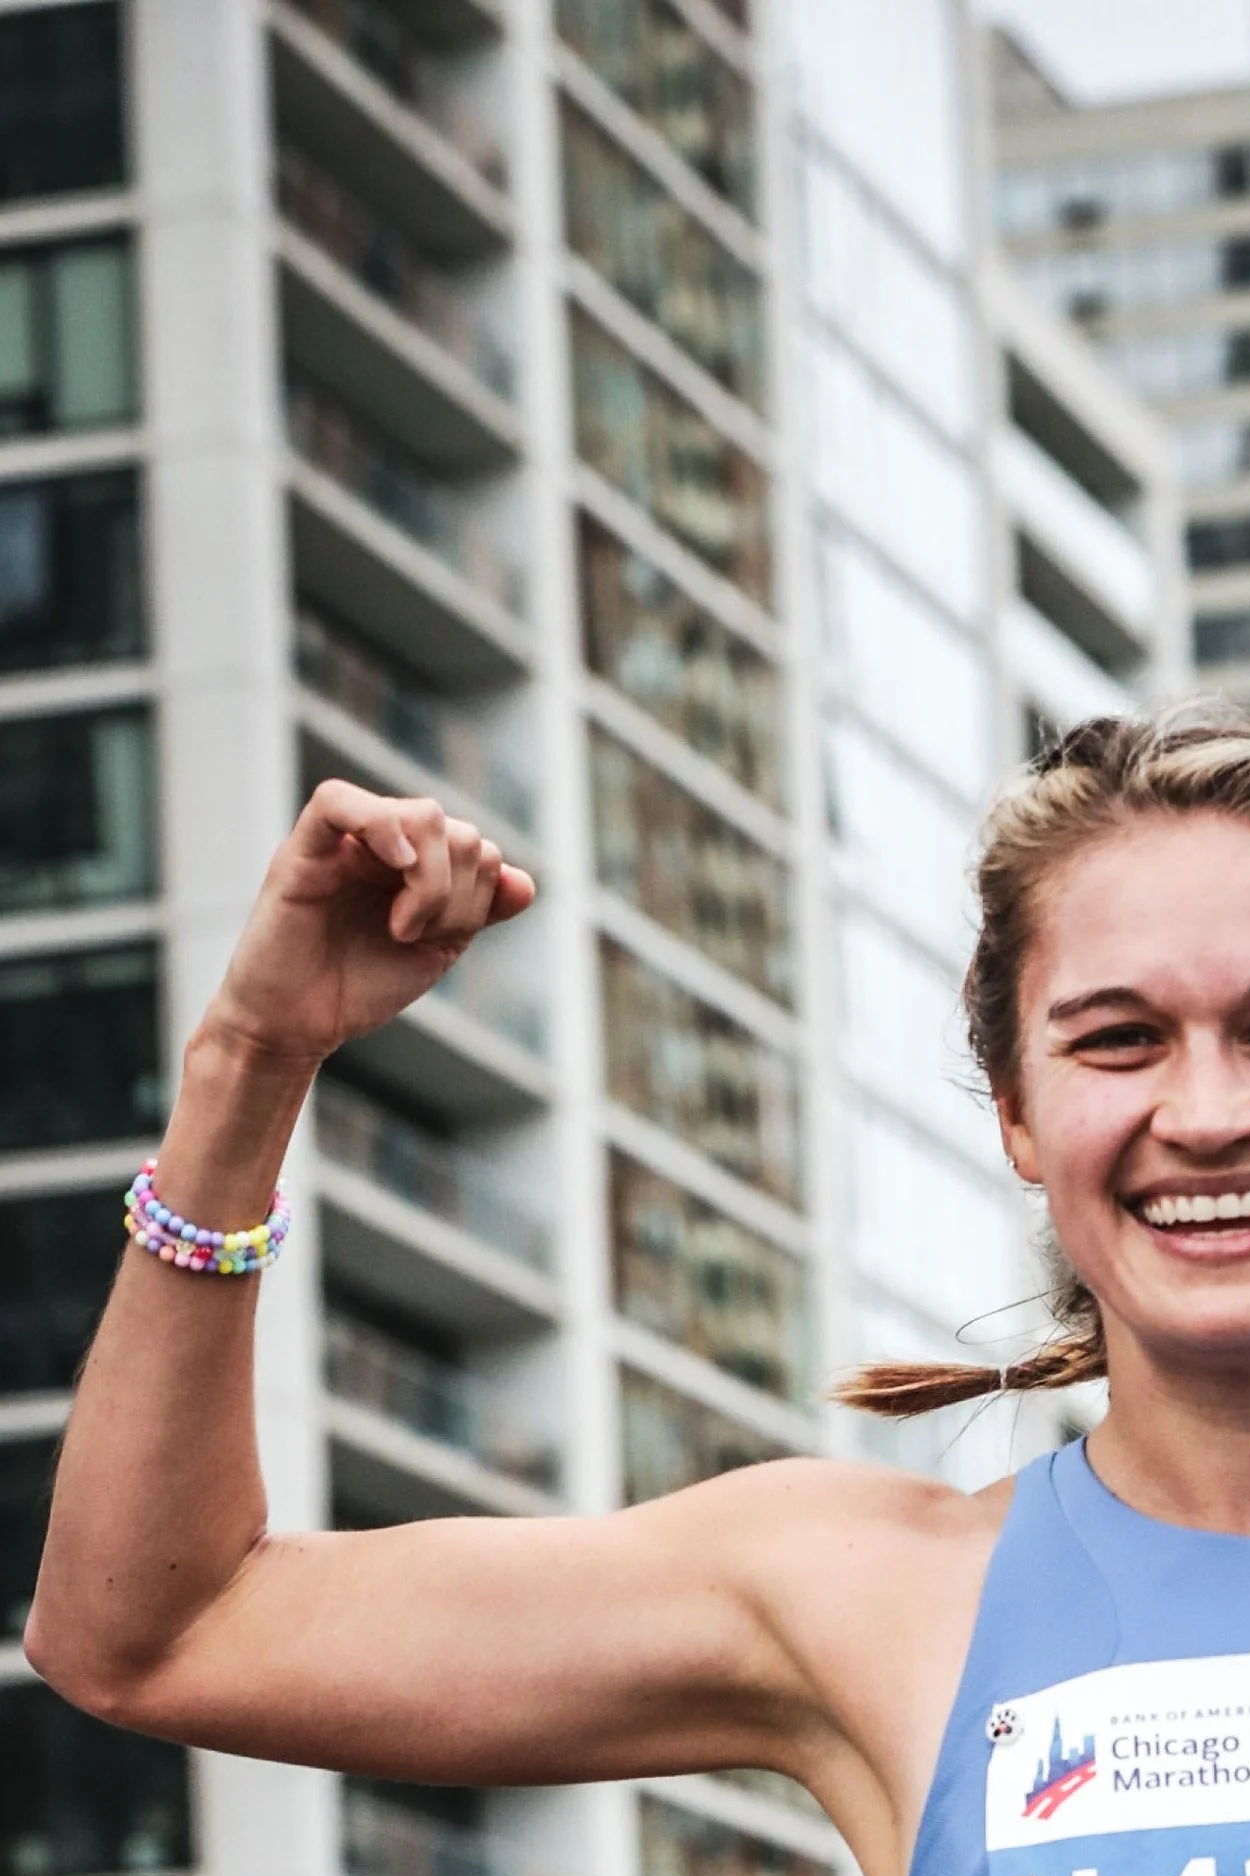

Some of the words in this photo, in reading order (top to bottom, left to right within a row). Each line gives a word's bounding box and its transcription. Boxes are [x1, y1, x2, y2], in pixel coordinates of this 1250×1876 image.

[1110, 1712, 1158, 1725] BANK
[1166, 1710, 1187, 1721] OF
[1111, 1733, 1240, 1761] Chicago
